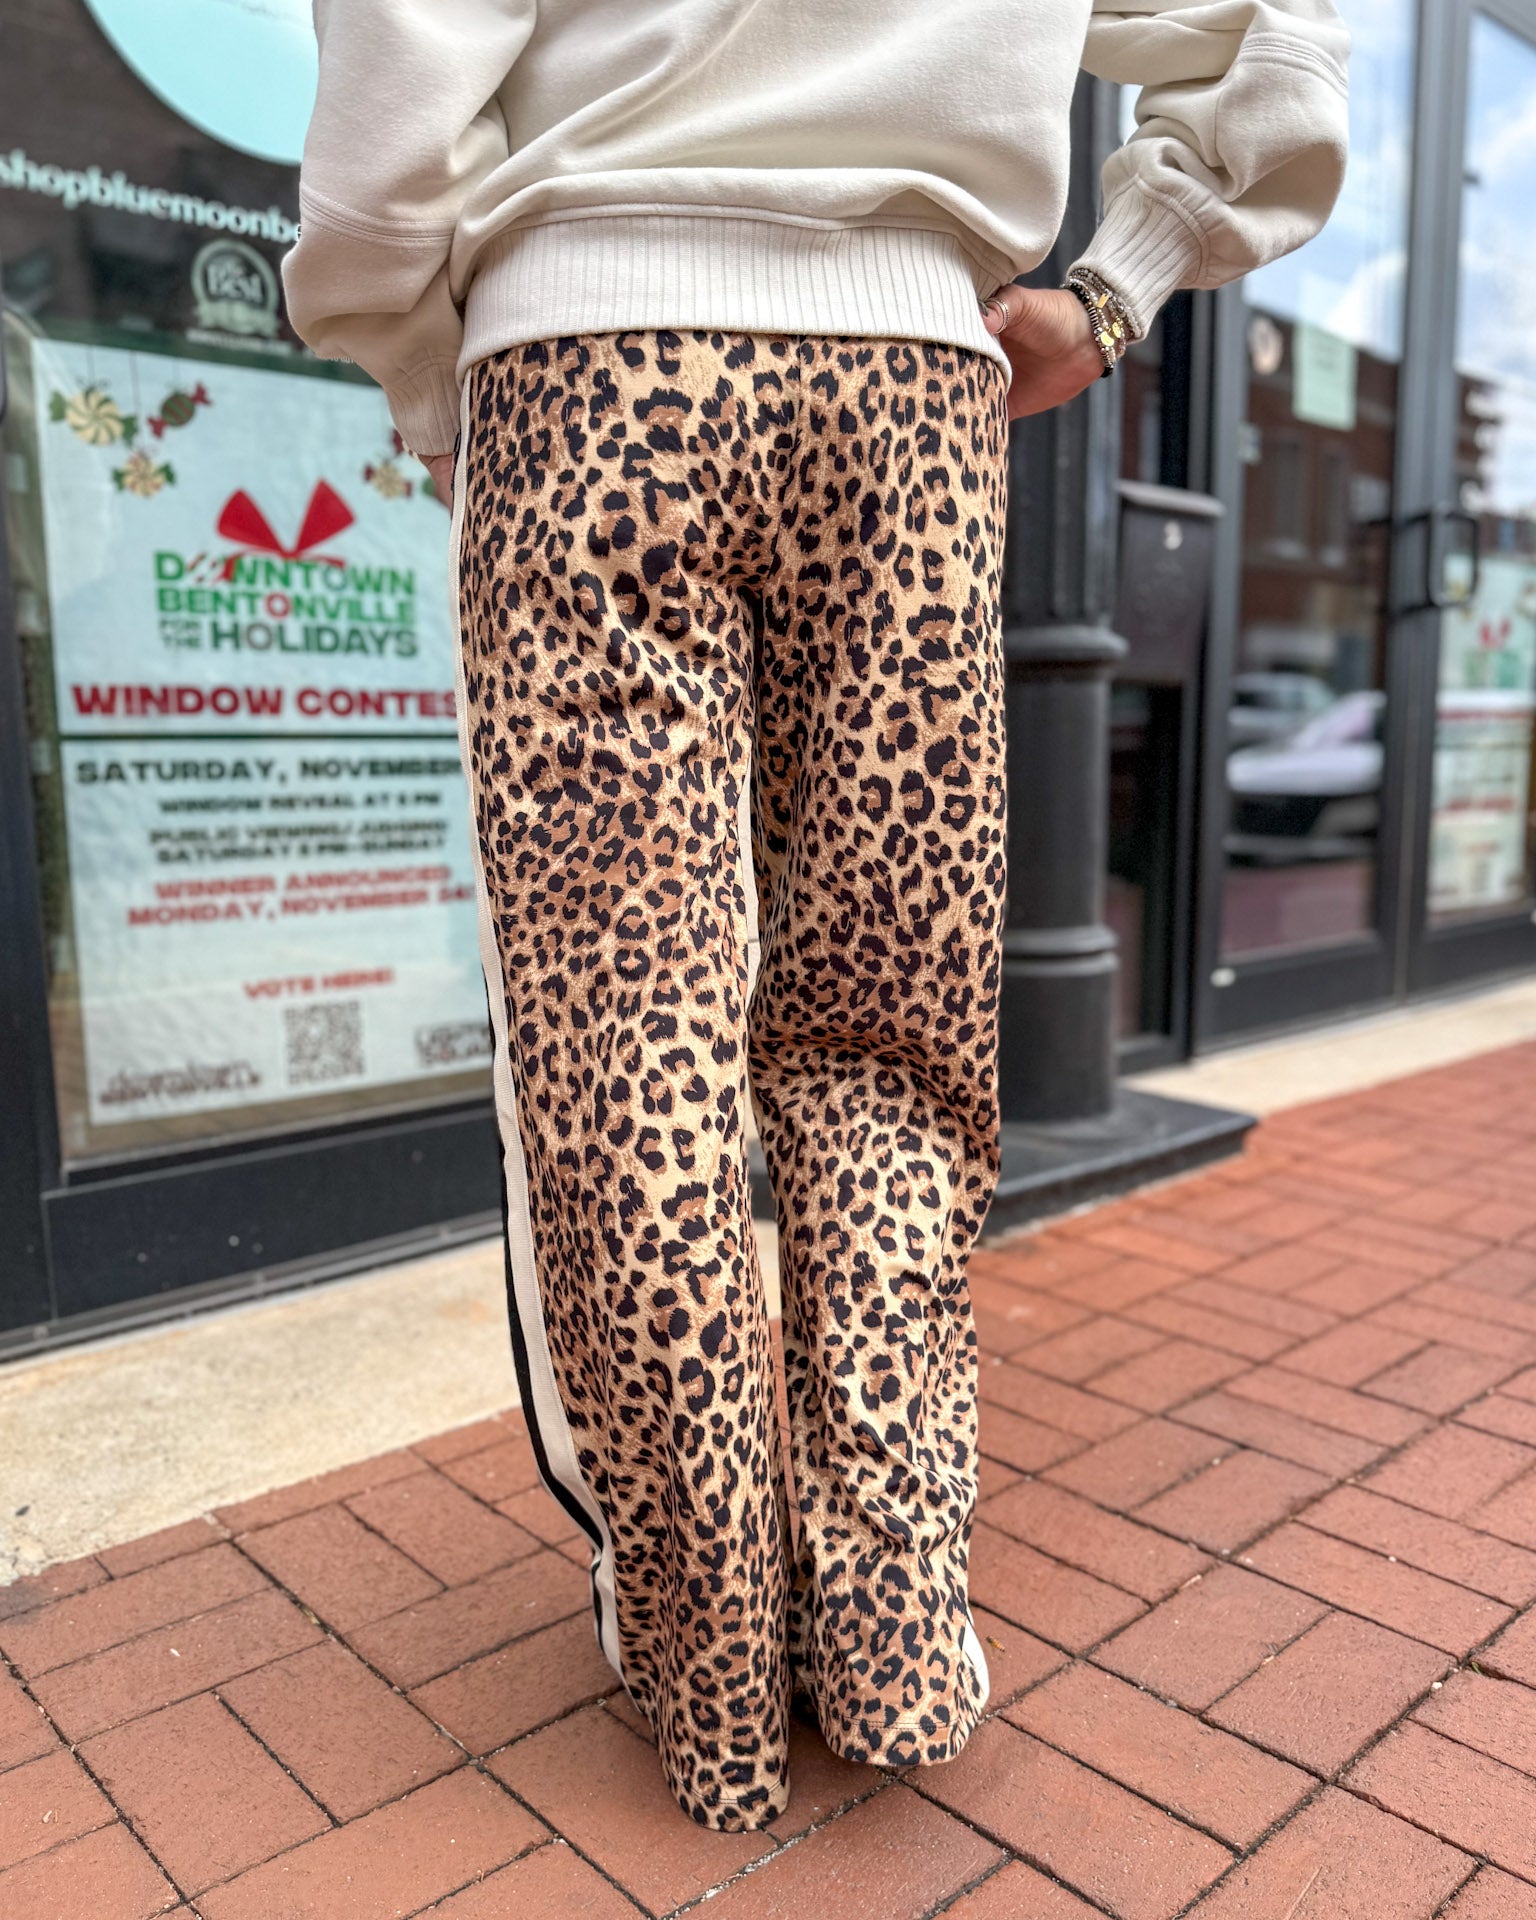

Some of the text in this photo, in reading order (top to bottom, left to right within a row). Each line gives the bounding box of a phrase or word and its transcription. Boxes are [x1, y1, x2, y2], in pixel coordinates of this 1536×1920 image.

[154, 551, 415, 595] DOWNTOWN
[156, 587, 414, 623] BENTONVILLE
[209, 621, 419, 658] HOLIDAYS
[71, 685, 284, 717] WINDOW
[76, 758, 287, 784] SATURDAY,
[158, 797, 260, 813] WINDOW
[270, 795, 354, 811] REVEAL
[364, 793, 392, 808] AT
[151, 824, 238, 843] PUBLIC
[156, 845, 291, 862] SATURDAY
[155, 865, 451, 900] WINNER ANNOUNCED
[128, 899, 277, 926] MONDAY,
[281, 888, 429, 917] NOVEMBER
[244, 974, 315, 999] VOTE
